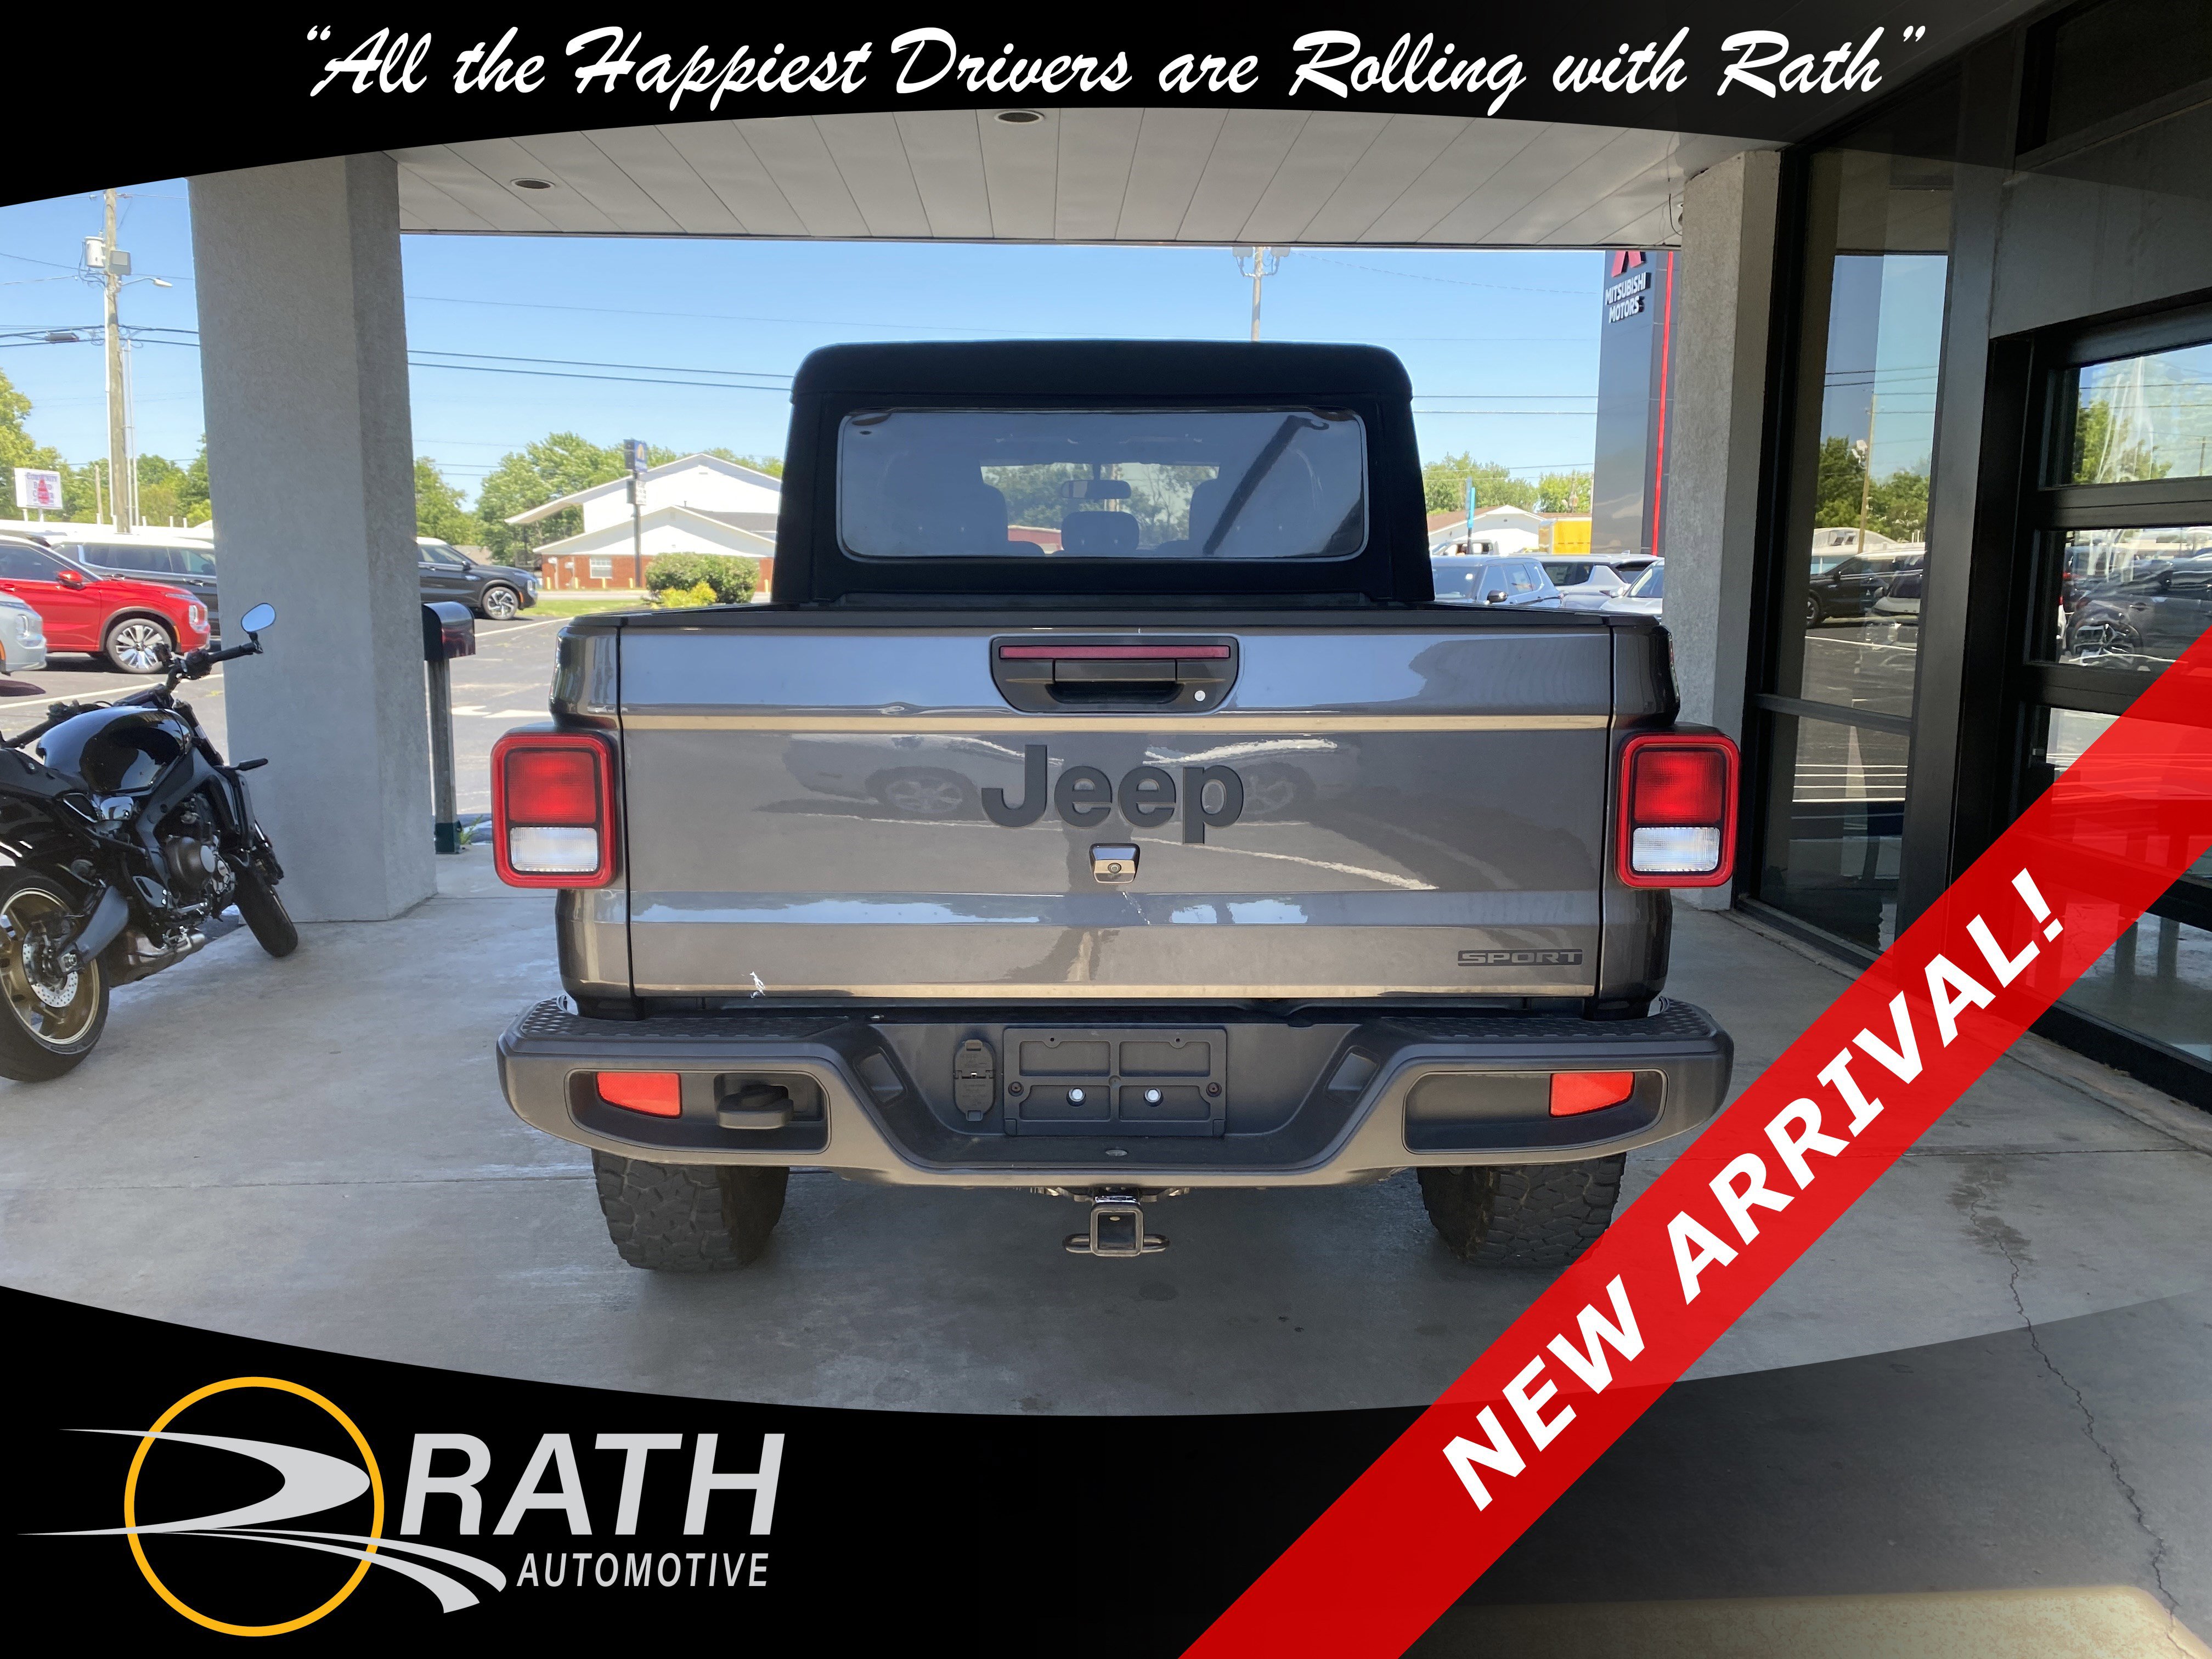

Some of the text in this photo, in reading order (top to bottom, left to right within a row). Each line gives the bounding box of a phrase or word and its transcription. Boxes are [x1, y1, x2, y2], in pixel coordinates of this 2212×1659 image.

[1605, 272, 1646, 306] MITSUBISHI
[1608, 295, 1640, 324] MOTORS
[981, 744, 1244, 845] Jeep
[1458, 952, 1583, 964] SPORT
